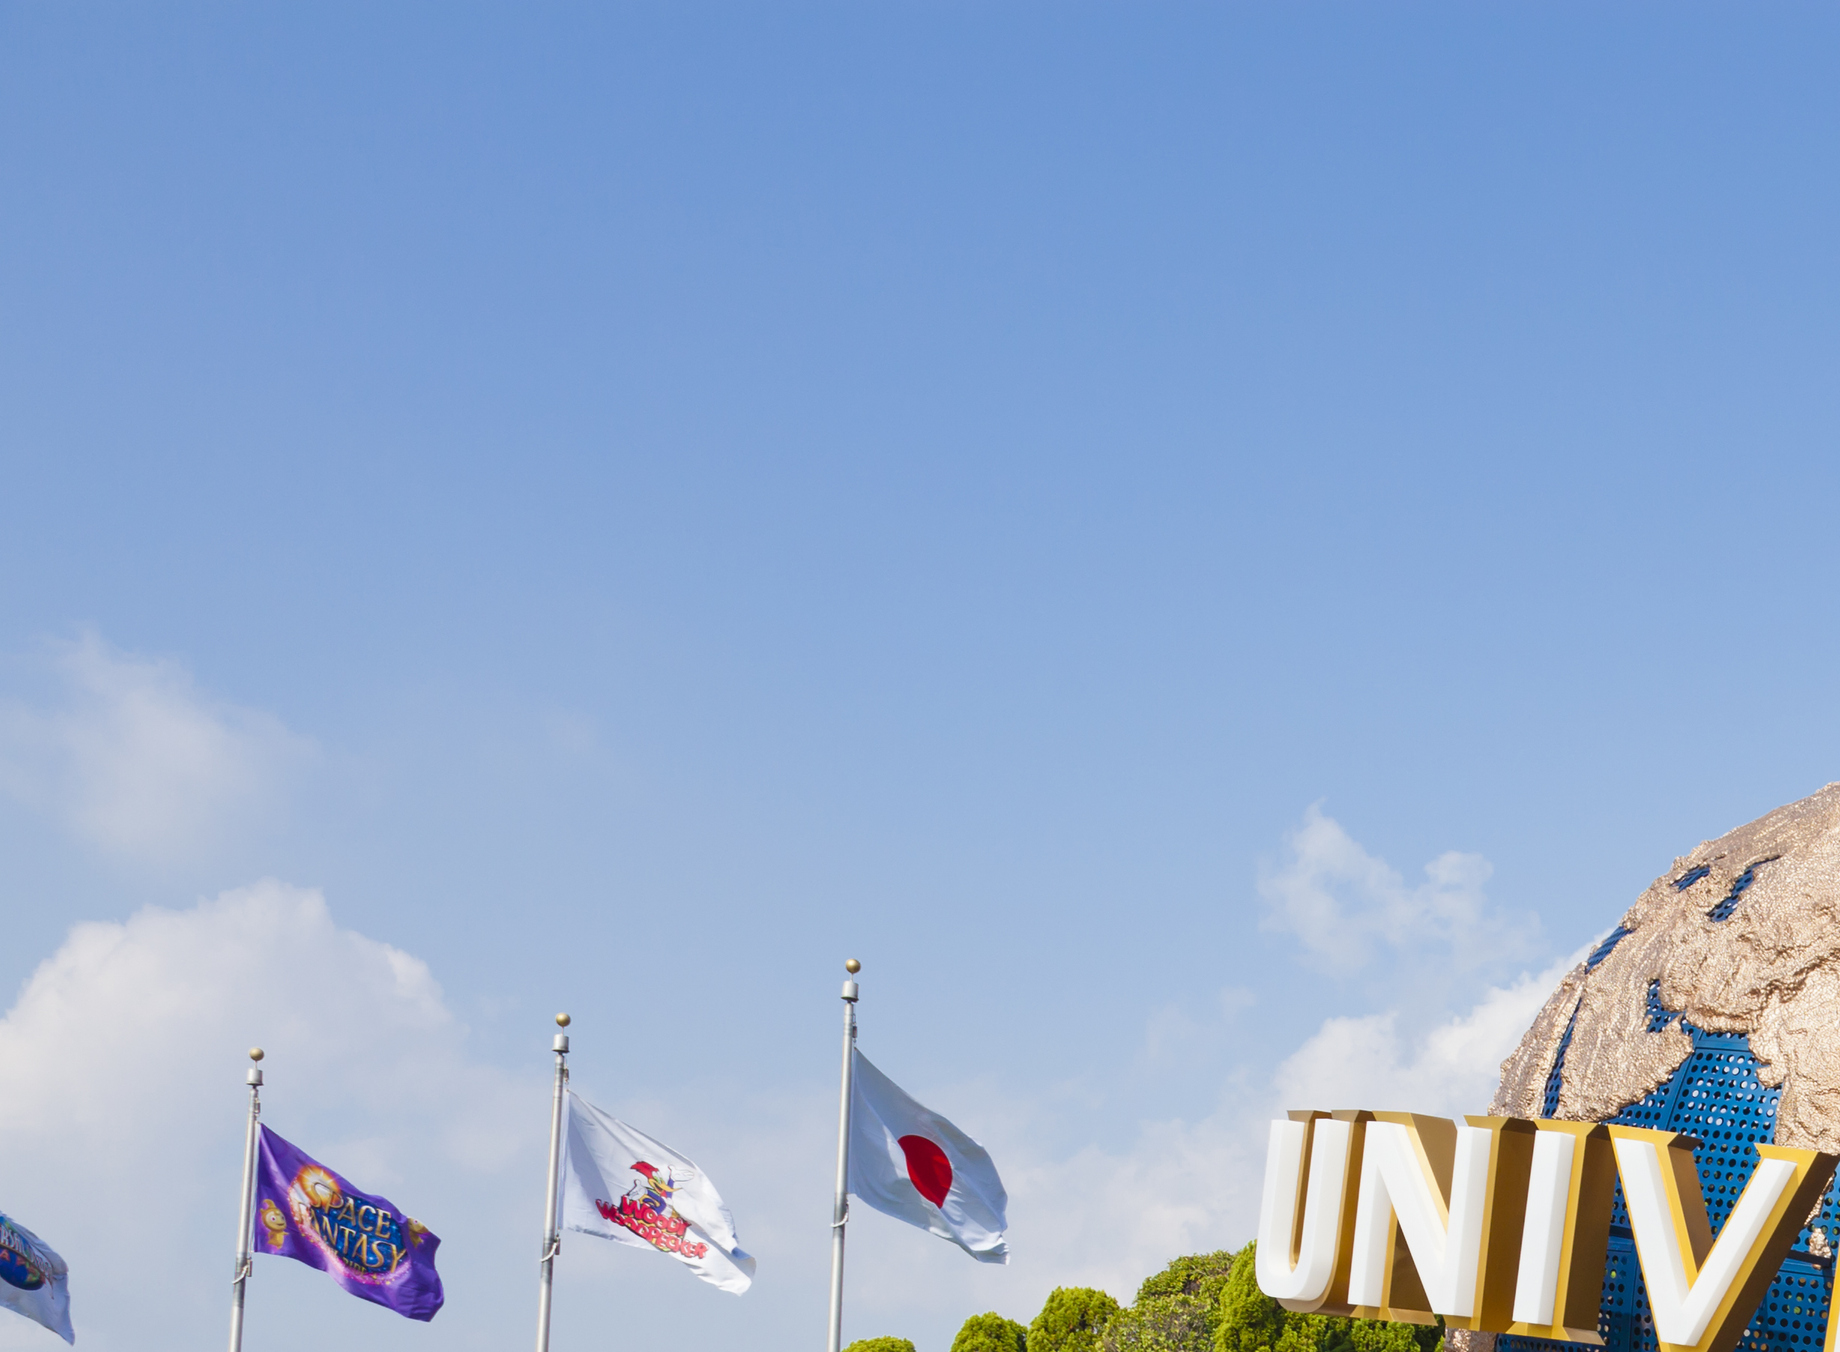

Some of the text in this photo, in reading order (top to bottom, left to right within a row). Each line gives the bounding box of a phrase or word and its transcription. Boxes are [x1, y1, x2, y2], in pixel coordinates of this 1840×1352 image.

[310, 1181, 391, 1239] SPACE
[595, 1199, 708, 1259] WOODPECKER
[620, 1194, 691, 1236] WOODY
